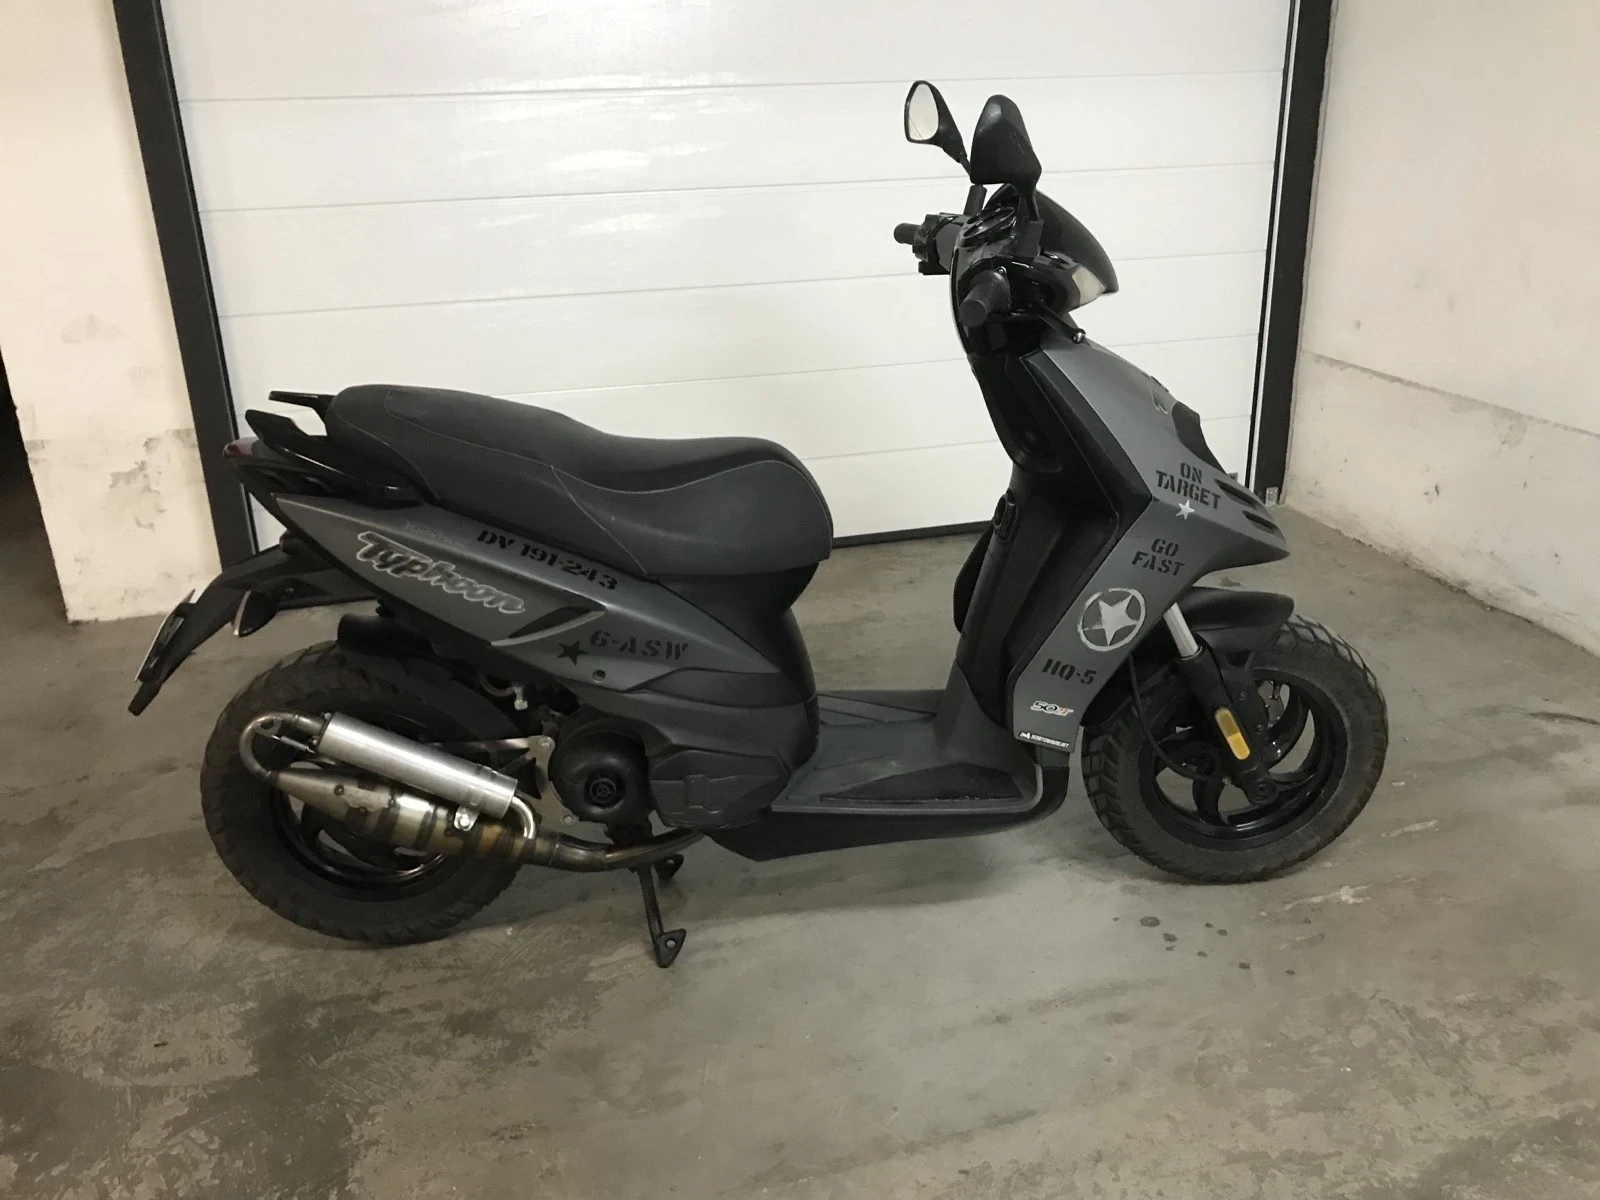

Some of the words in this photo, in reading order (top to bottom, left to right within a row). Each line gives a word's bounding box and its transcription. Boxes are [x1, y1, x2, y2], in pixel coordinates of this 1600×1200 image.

[1180, 462, 1202, 482] ON
[1156, 470, 1221, 509] TARGET
[477, 530, 515, 549] DV
[520, 544, 618, 590] 191-243
[1132, 551, 1185, 576] FAST
[1151, 538, 1179, 557] GO
[356, 531, 525, 613] Typhoon
